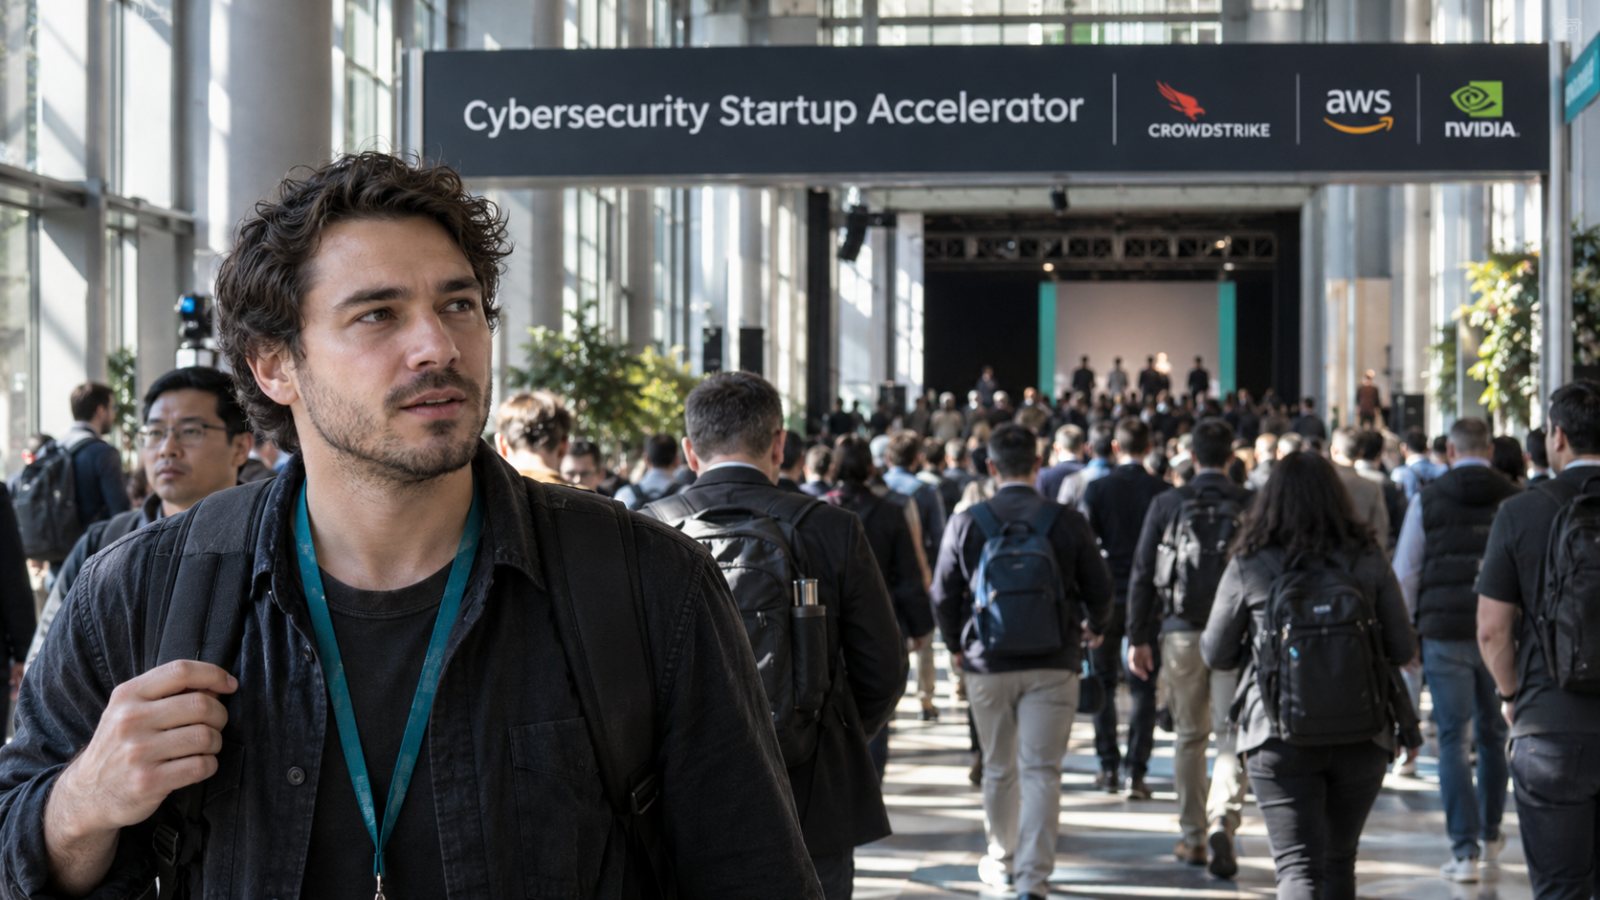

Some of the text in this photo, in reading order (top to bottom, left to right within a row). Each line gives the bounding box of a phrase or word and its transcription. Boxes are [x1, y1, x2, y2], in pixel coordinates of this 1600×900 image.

[463, 91, 1084, 138] Cybersecurity Startup Accelerator
[1326, 89, 1391, 115] aws
[1148, 123, 1270, 138] CROWDSTRIKE
